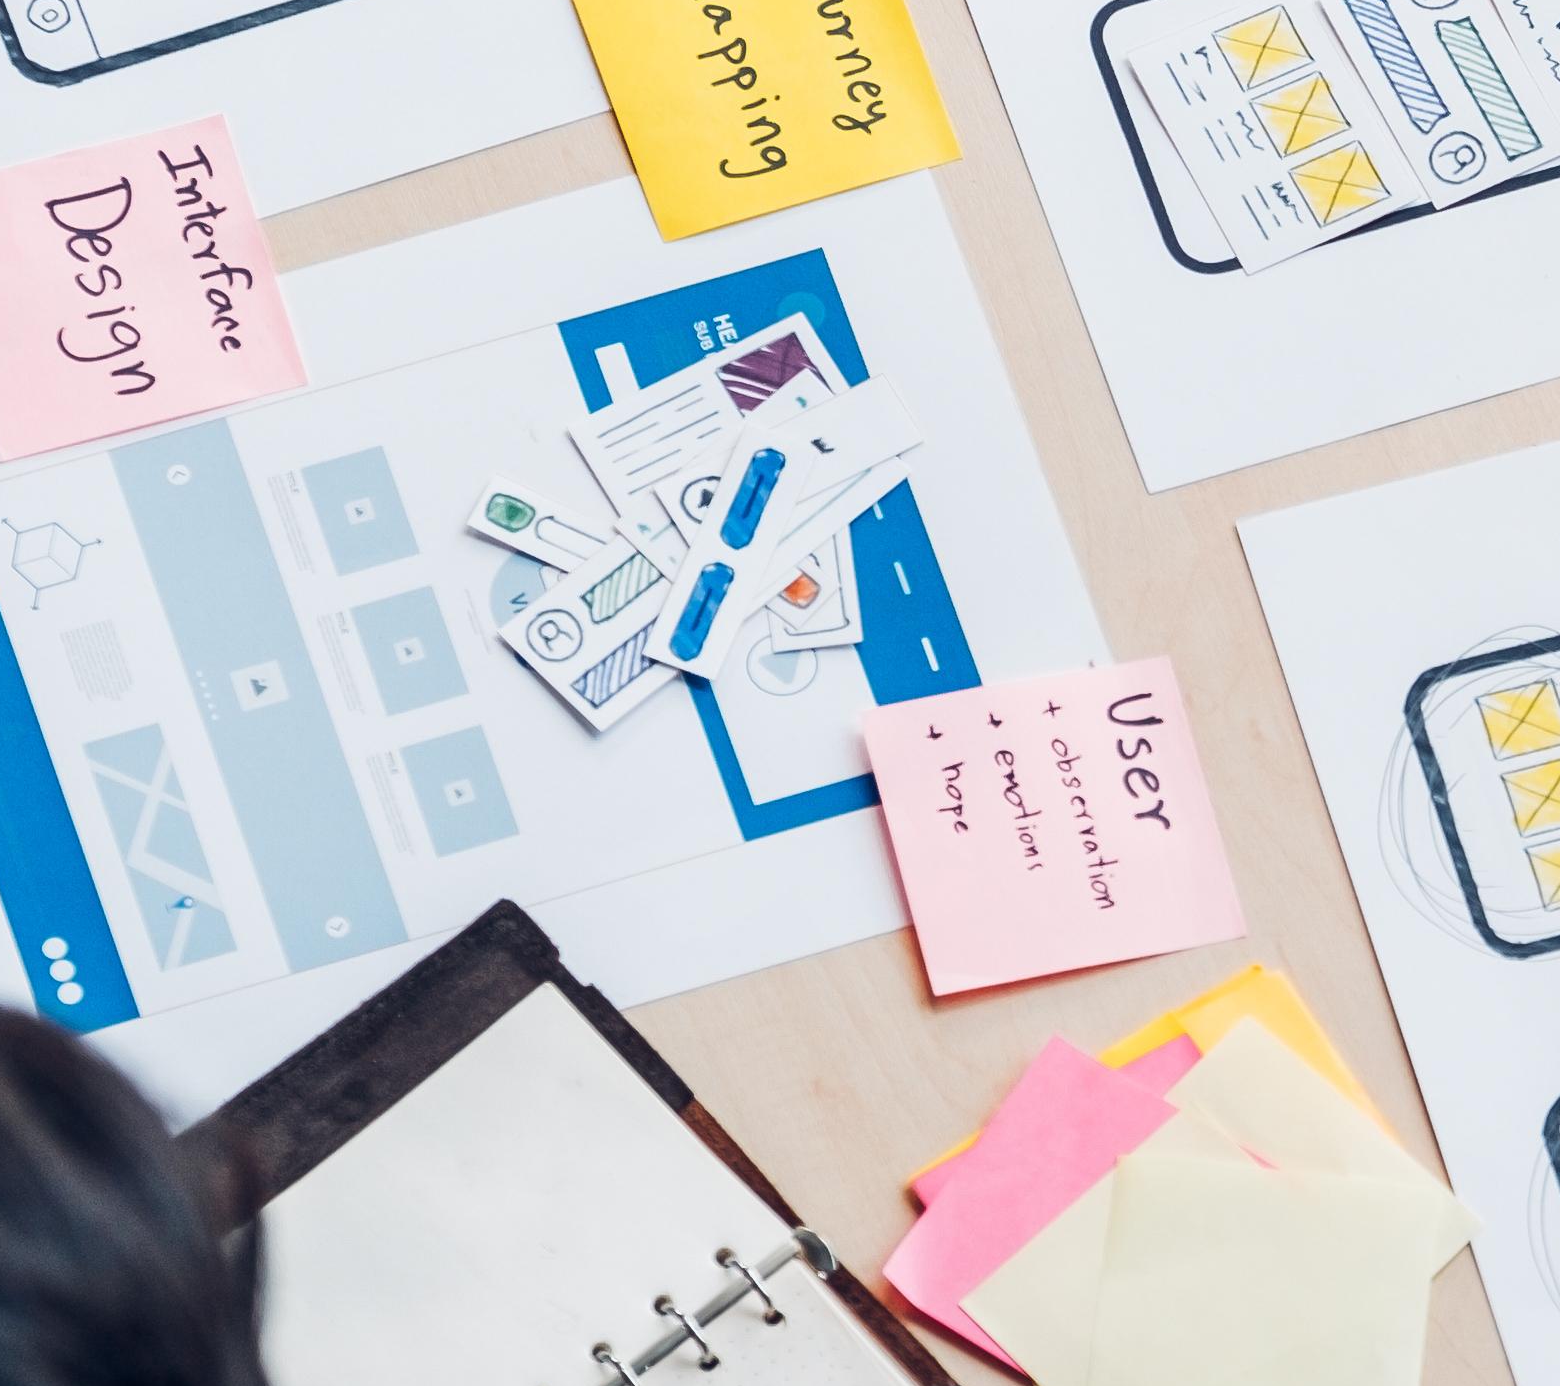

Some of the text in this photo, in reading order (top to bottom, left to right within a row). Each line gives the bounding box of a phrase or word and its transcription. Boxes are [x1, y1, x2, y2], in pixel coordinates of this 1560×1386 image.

[44, 176, 156, 395] Design
[157, 144, 254, 352] Interface
[937, 761, 969, 833] hope
[994, 750, 1043, 870] emotions
[1051, 738, 1119, 910] observation
[1107, 693, 1170, 831] User
